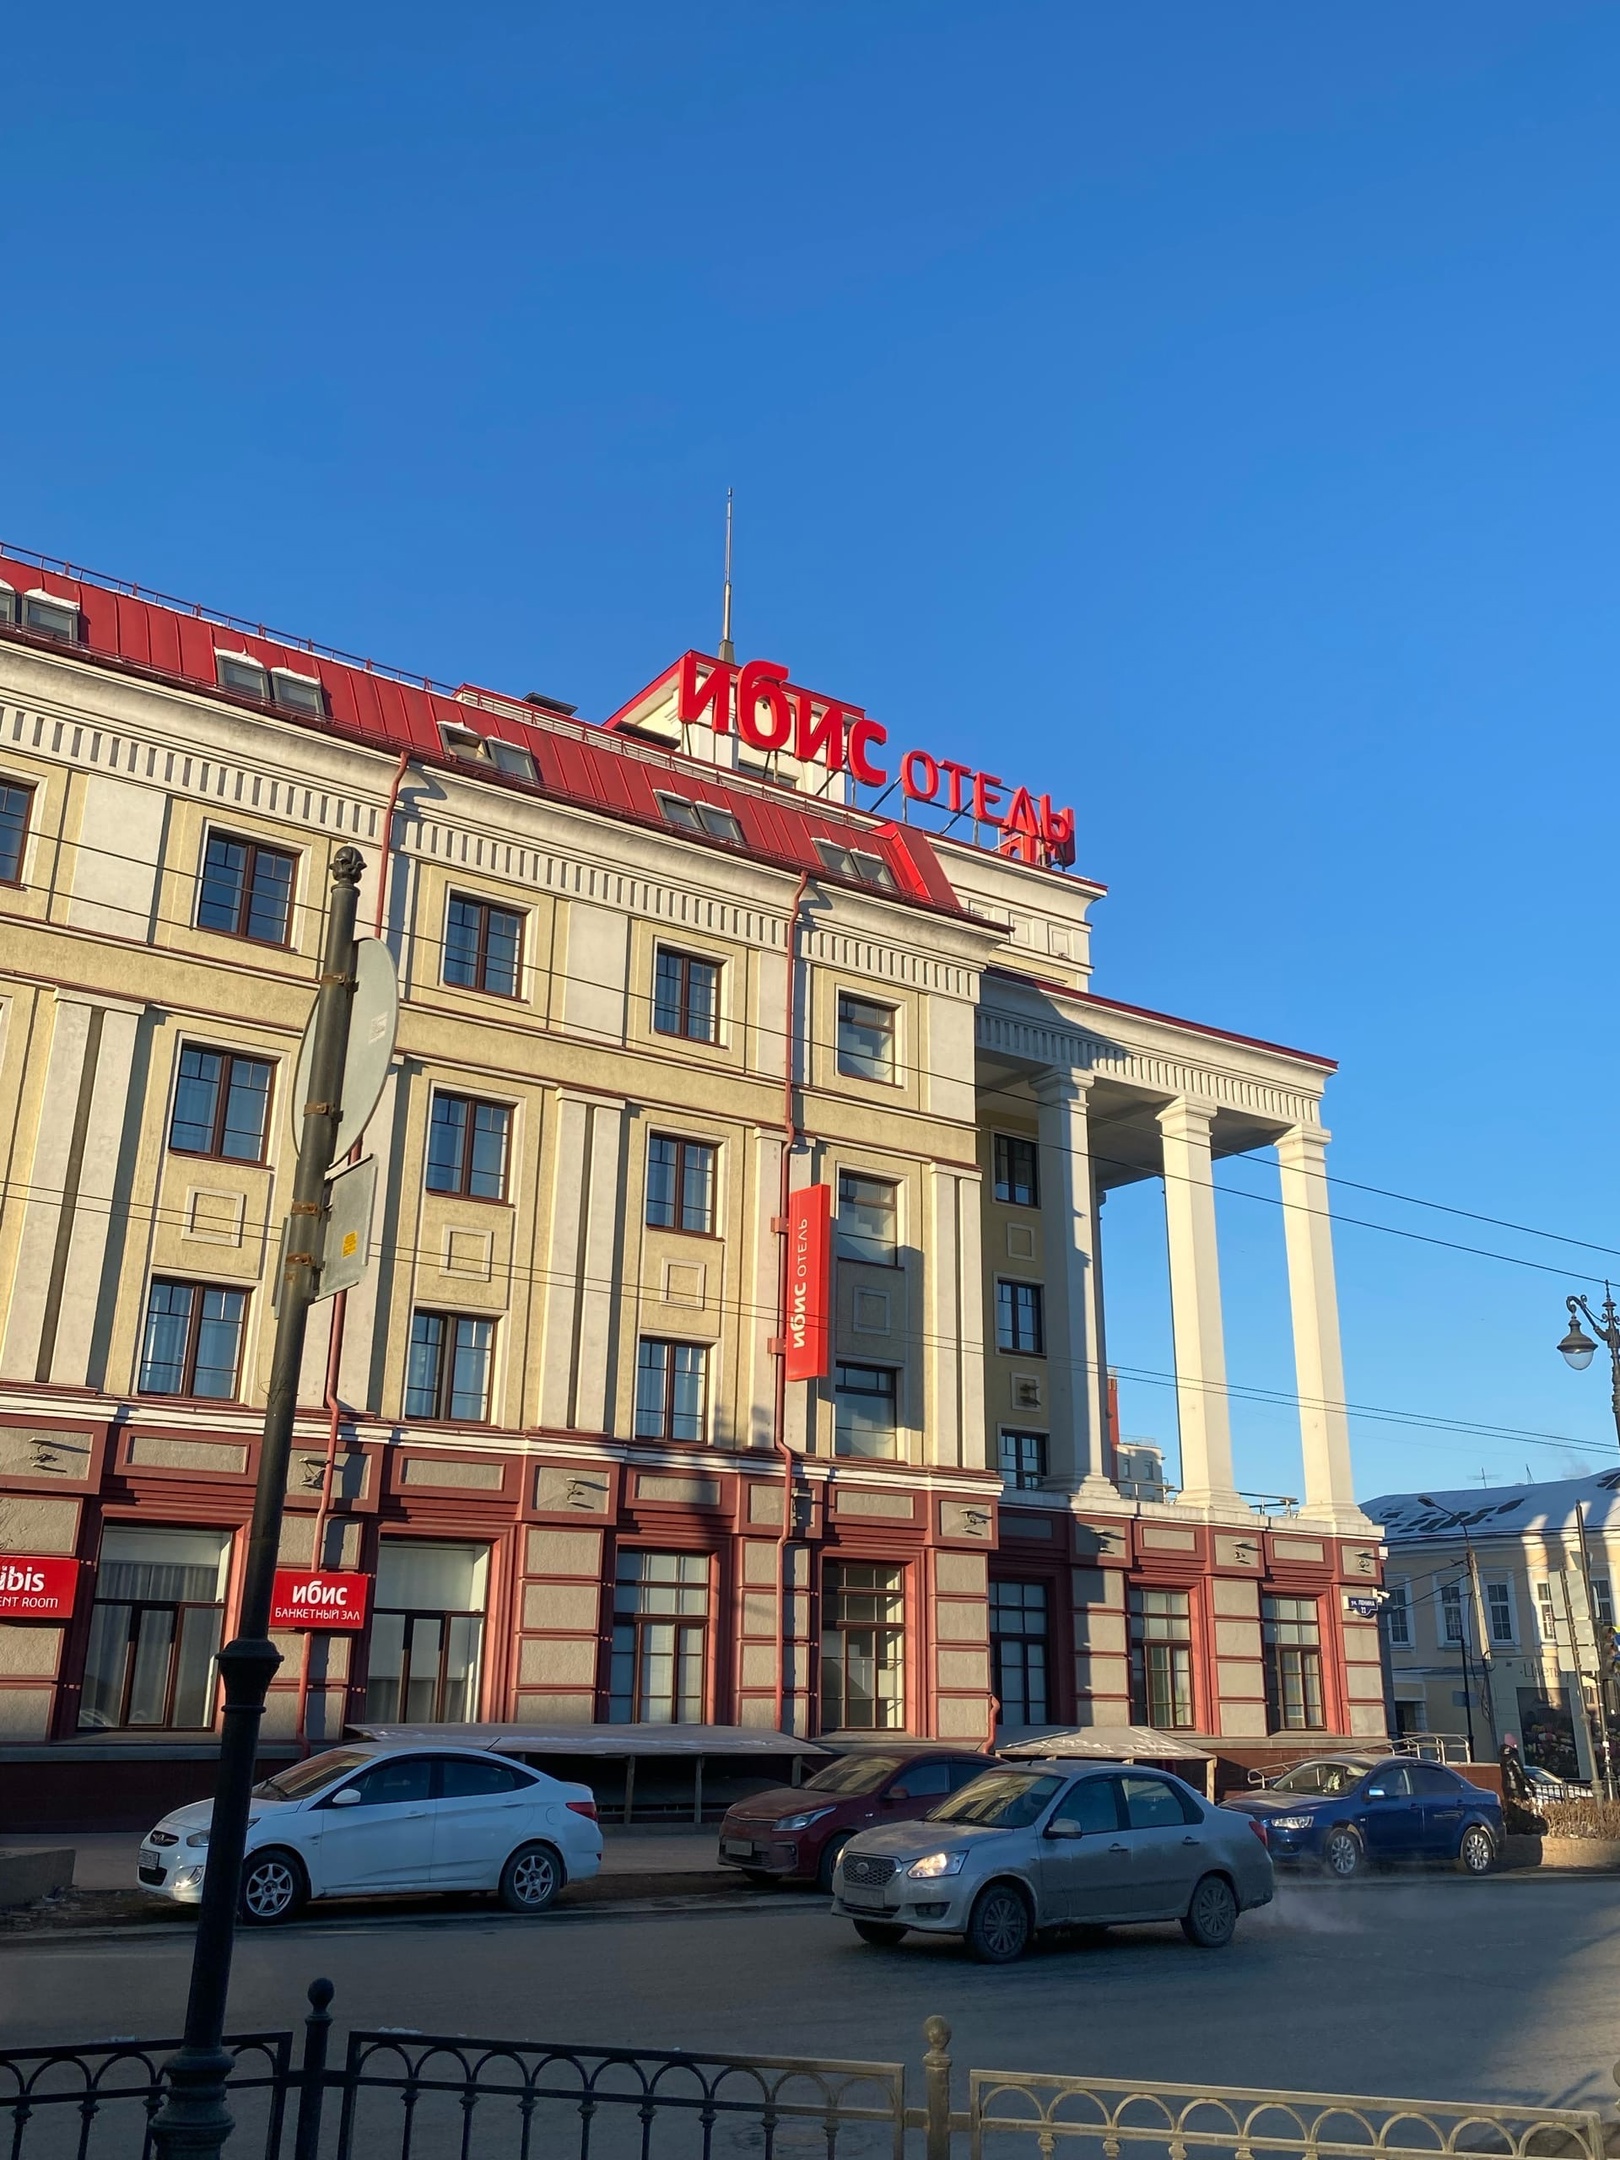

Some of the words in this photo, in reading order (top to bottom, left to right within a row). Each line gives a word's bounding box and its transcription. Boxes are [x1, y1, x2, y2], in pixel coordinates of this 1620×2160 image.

[678, 656, 888, 787] ибис
[901, 749, 1071, 844] ОТЕЛЬ
[797, 1218, 808, 1277] ОТЕЛЬ
[790, 1282, 806, 1348] ибис
[0, 1566, 45, 1592] ibis
[0, 1596, 19, 1607] NT
[22, 1597, 58, 1608] ROOM
[292, 1580, 348, 1605] ибис
[275, 1607, 339, 1620] БАНКЕТНЫЙ
[341, 1610, 360, 1620] ЗАЛ
